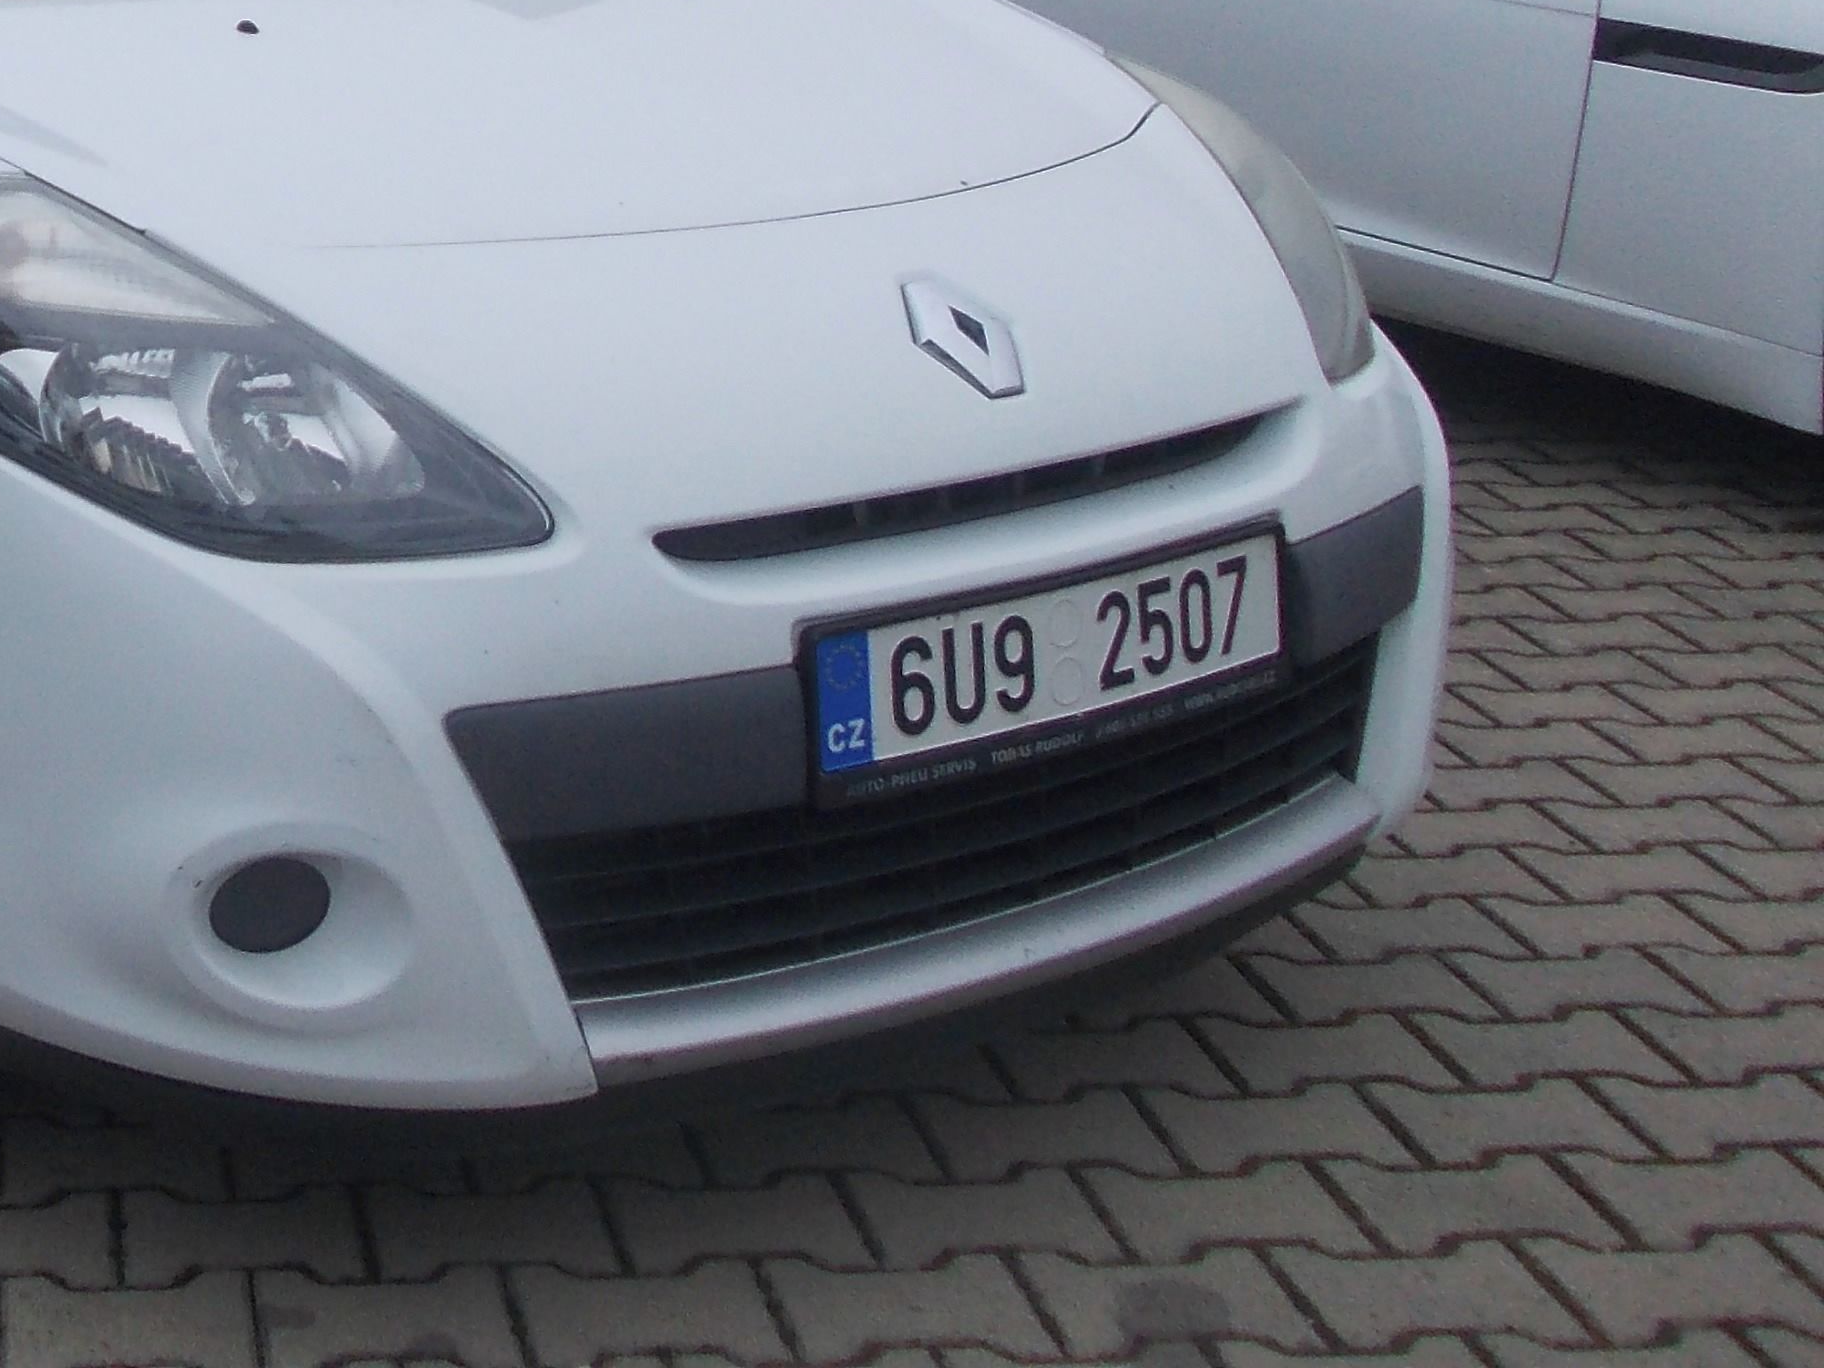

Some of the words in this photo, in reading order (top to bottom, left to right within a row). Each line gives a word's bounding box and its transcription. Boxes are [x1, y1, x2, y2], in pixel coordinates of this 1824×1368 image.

[890, 614, 1035, 735] 6U9
[1097, 554, 1247, 691] 2507
[827, 718, 866, 754] CZ
